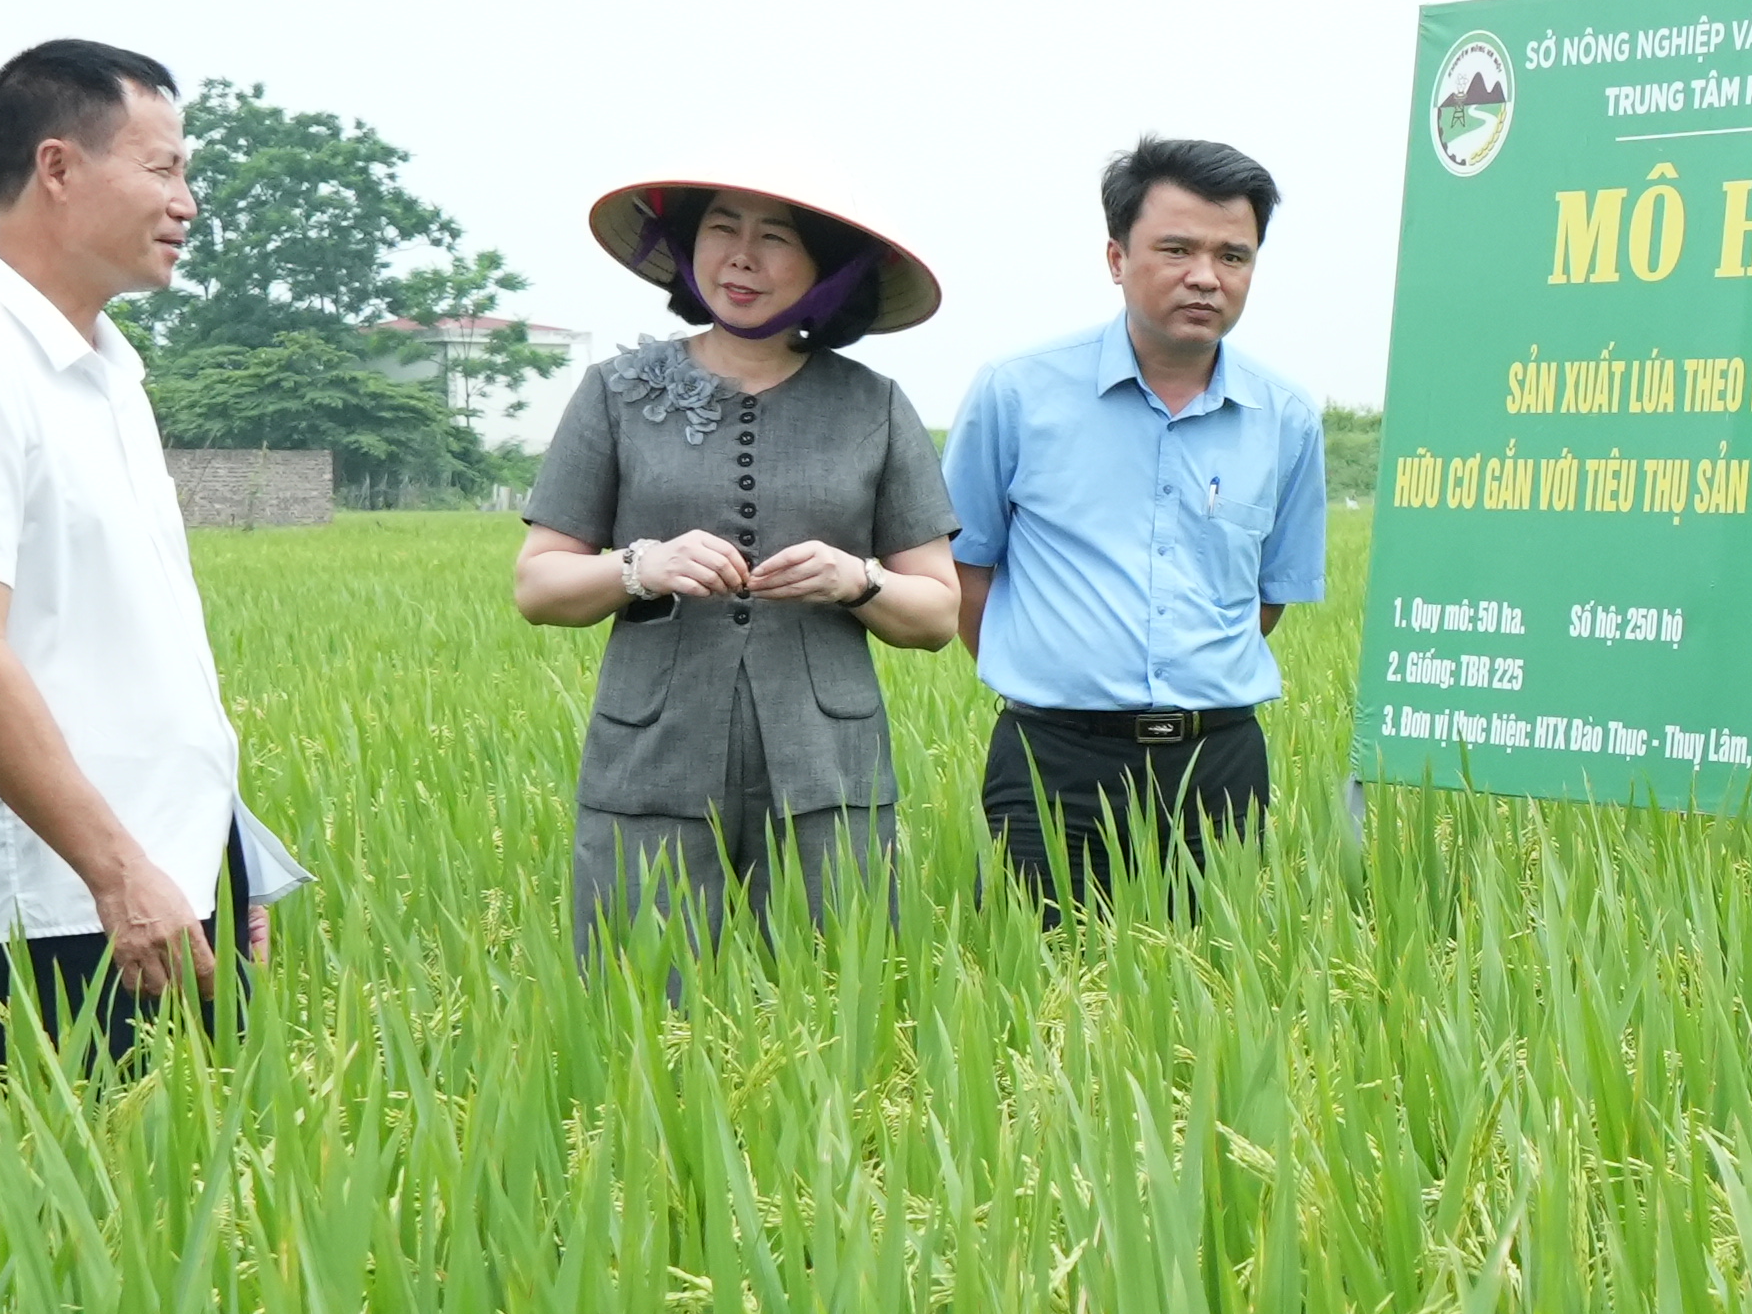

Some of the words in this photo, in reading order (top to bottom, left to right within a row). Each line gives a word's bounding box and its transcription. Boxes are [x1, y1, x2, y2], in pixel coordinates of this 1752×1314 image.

[1525, 29, 1557, 70] SỞ
[1562, 27, 1630, 67] NÔNG
[1636, 16, 1725, 63] NGHIỆP
[1605, 83, 1685, 117] TRUNG
[1691, 70, 1740, 110] TÂM
[1547, 162, 1685, 285] MÔ
[1506, 344, 1557, 414] SẢN
[1560, 341, 1626, 414] XUẤT
[1628, 347, 1674, 414] LÚA
[1683, 358, 1745, 414] THEO
[1394, 447, 1443, 508] HỮU
[1447, 453, 1481, 509] CƠ
[1483, 438, 1534, 510] GẮN
[1539, 448, 1580, 511] VỚI
[1585, 447, 1638, 512] TIÊU
[1642, 459, 1690, 526] THỤ
[1694, 440, 1749, 514] SẢN
[1394, 597, 1406, 628] 1.
[1411, 597, 1442, 633] Quy
[1444, 599, 1474, 632] mô:
[1477, 600, 1498, 633] 50
[1501, 602, 1525, 634] ha.
[1569, 600, 1595, 638] Số
[1595, 605, 1622, 646] hộ:
[1625, 608, 1658, 641] 250
[1660, 608, 1683, 649] hộ
[1387, 651, 1401, 682] 2.
[1406, 648, 1456, 689] Giống:
[1460, 654, 1490, 688] TBR
[1492, 657, 1524, 691] 225
[1382, 705, 1396, 736] 3.
[1400, 706, 1431, 739] Đơn
[1435, 709, 1450, 747] vị
[1452, 710, 1487, 750] thực
[1490, 713, 1531, 754] hiện:
[1534, 716, 1568, 749] HTX
[1570, 716, 1603, 752] Đào
[1608, 721, 1648, 761] Thục
[1652, 739, 1659, 747] -
[1708, 728, 1752, 769] Lâm,
